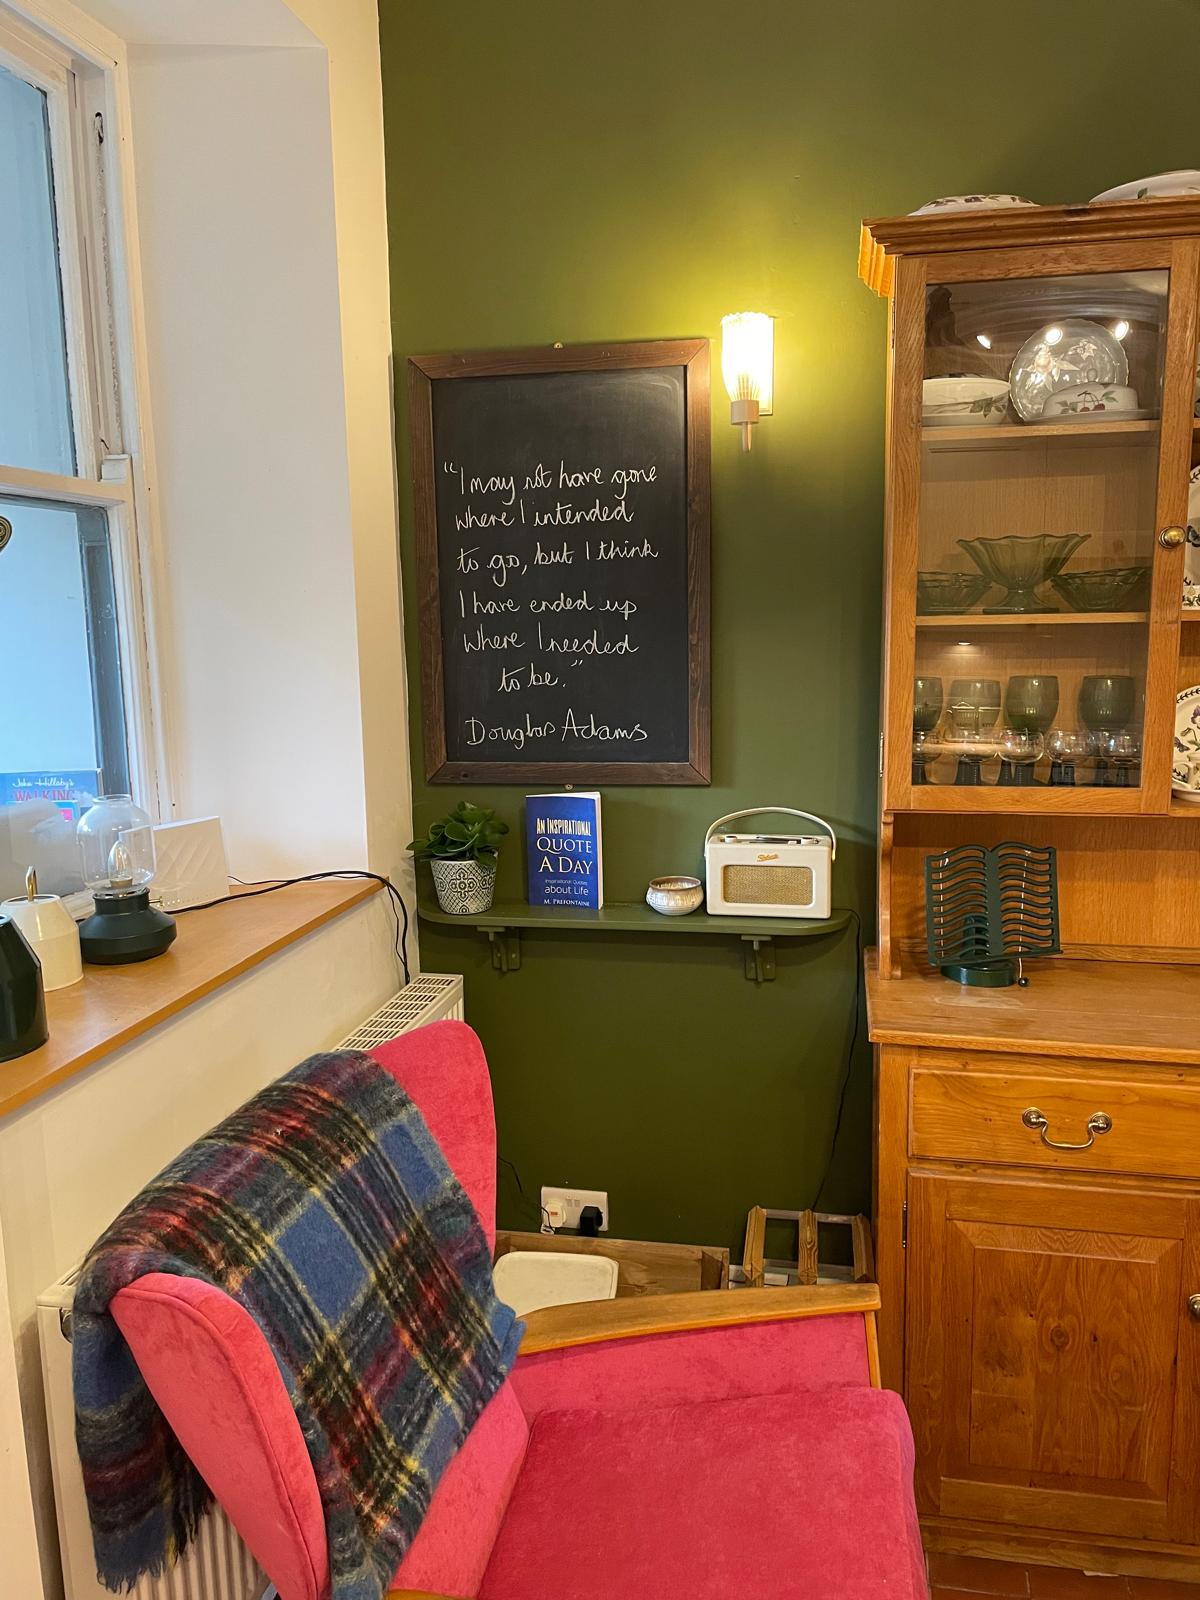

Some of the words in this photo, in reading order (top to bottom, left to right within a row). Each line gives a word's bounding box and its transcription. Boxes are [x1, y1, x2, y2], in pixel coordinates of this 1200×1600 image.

[470, 475, 516, 506] may
[522, 463, 552, 490] not
[559, 460, 605, 489] have
[611, 465, 658, 500] gone
[455, 505, 515, 531] where
[520, 499, 526, 524] I
[533, 499, 635, 527] intended
[457, 546, 481, 574] to
[486, 554, 528, 587] go,
[534, 541, 575, 565] but
[585, 541, 590, 560] I
[596, 538, 659, 561] think
[459, 590, 465, 618] I
[473, 591, 521, 614] have
[529, 590, 594, 613] ended
[599, 599, 638, 621] up
[538, 622, 543, 650] I
[545, 629, 639, 654] needed
[498, 667, 526, 692] to
[464, 713, 556, 750] Douglas
[561, 708, 648, 742] Adams
[546, 817, 592, 836] INSPIRATIONAL
[536, 836, 593, 854] QUOTE
[538, 855, 554, 873] A
[558, 856, 593, 875] DAY
[544, 885, 572, 894] about
[573, 886, 589, 896] Life
